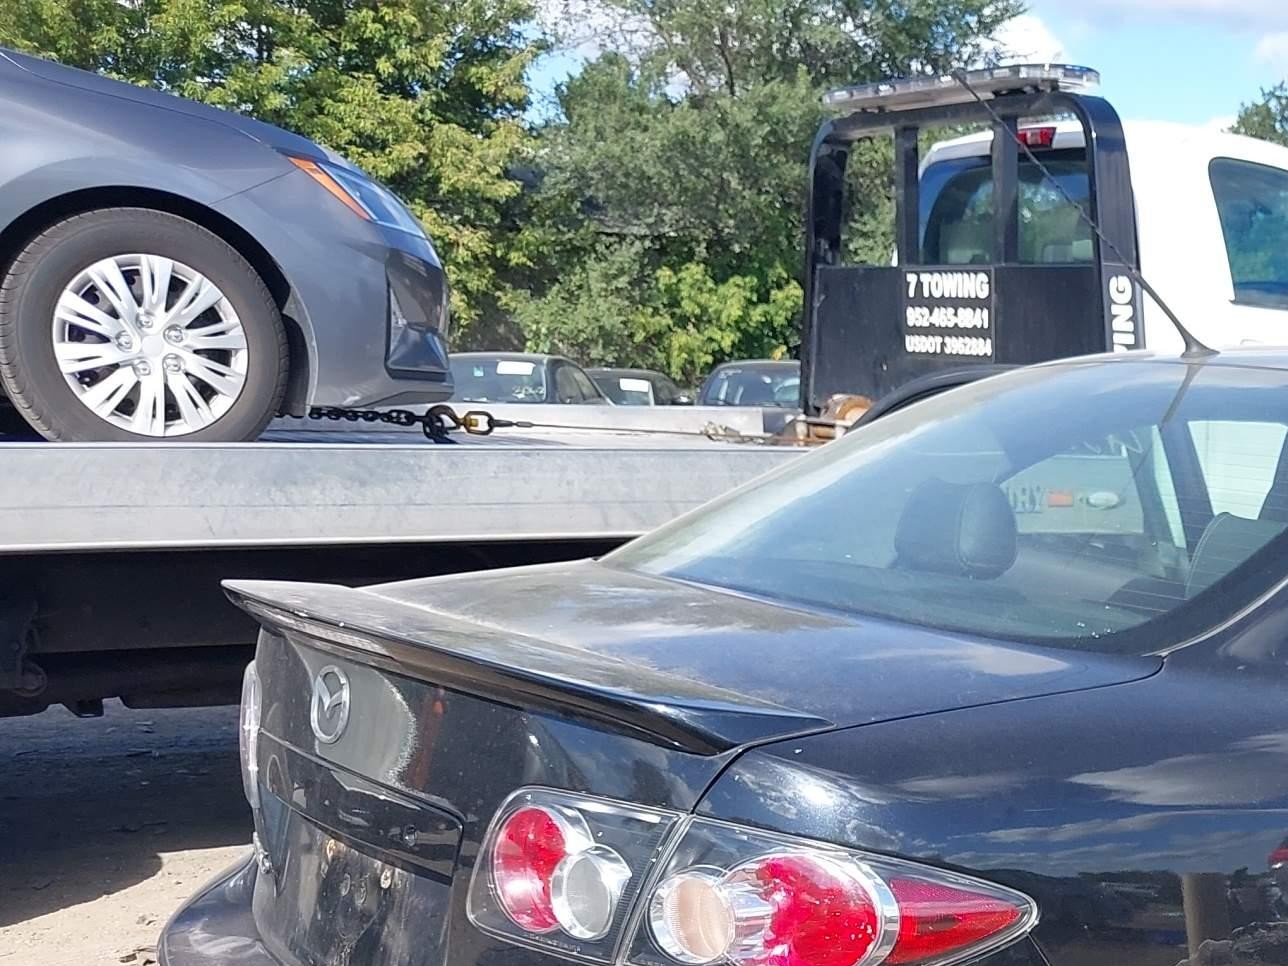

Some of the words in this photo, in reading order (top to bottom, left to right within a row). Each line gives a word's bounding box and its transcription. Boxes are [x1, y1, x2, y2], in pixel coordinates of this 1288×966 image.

[906, 272, 918, 298] 7
[920, 272, 989, 299] TOWING
[905, 335, 943, 354] USDOT
